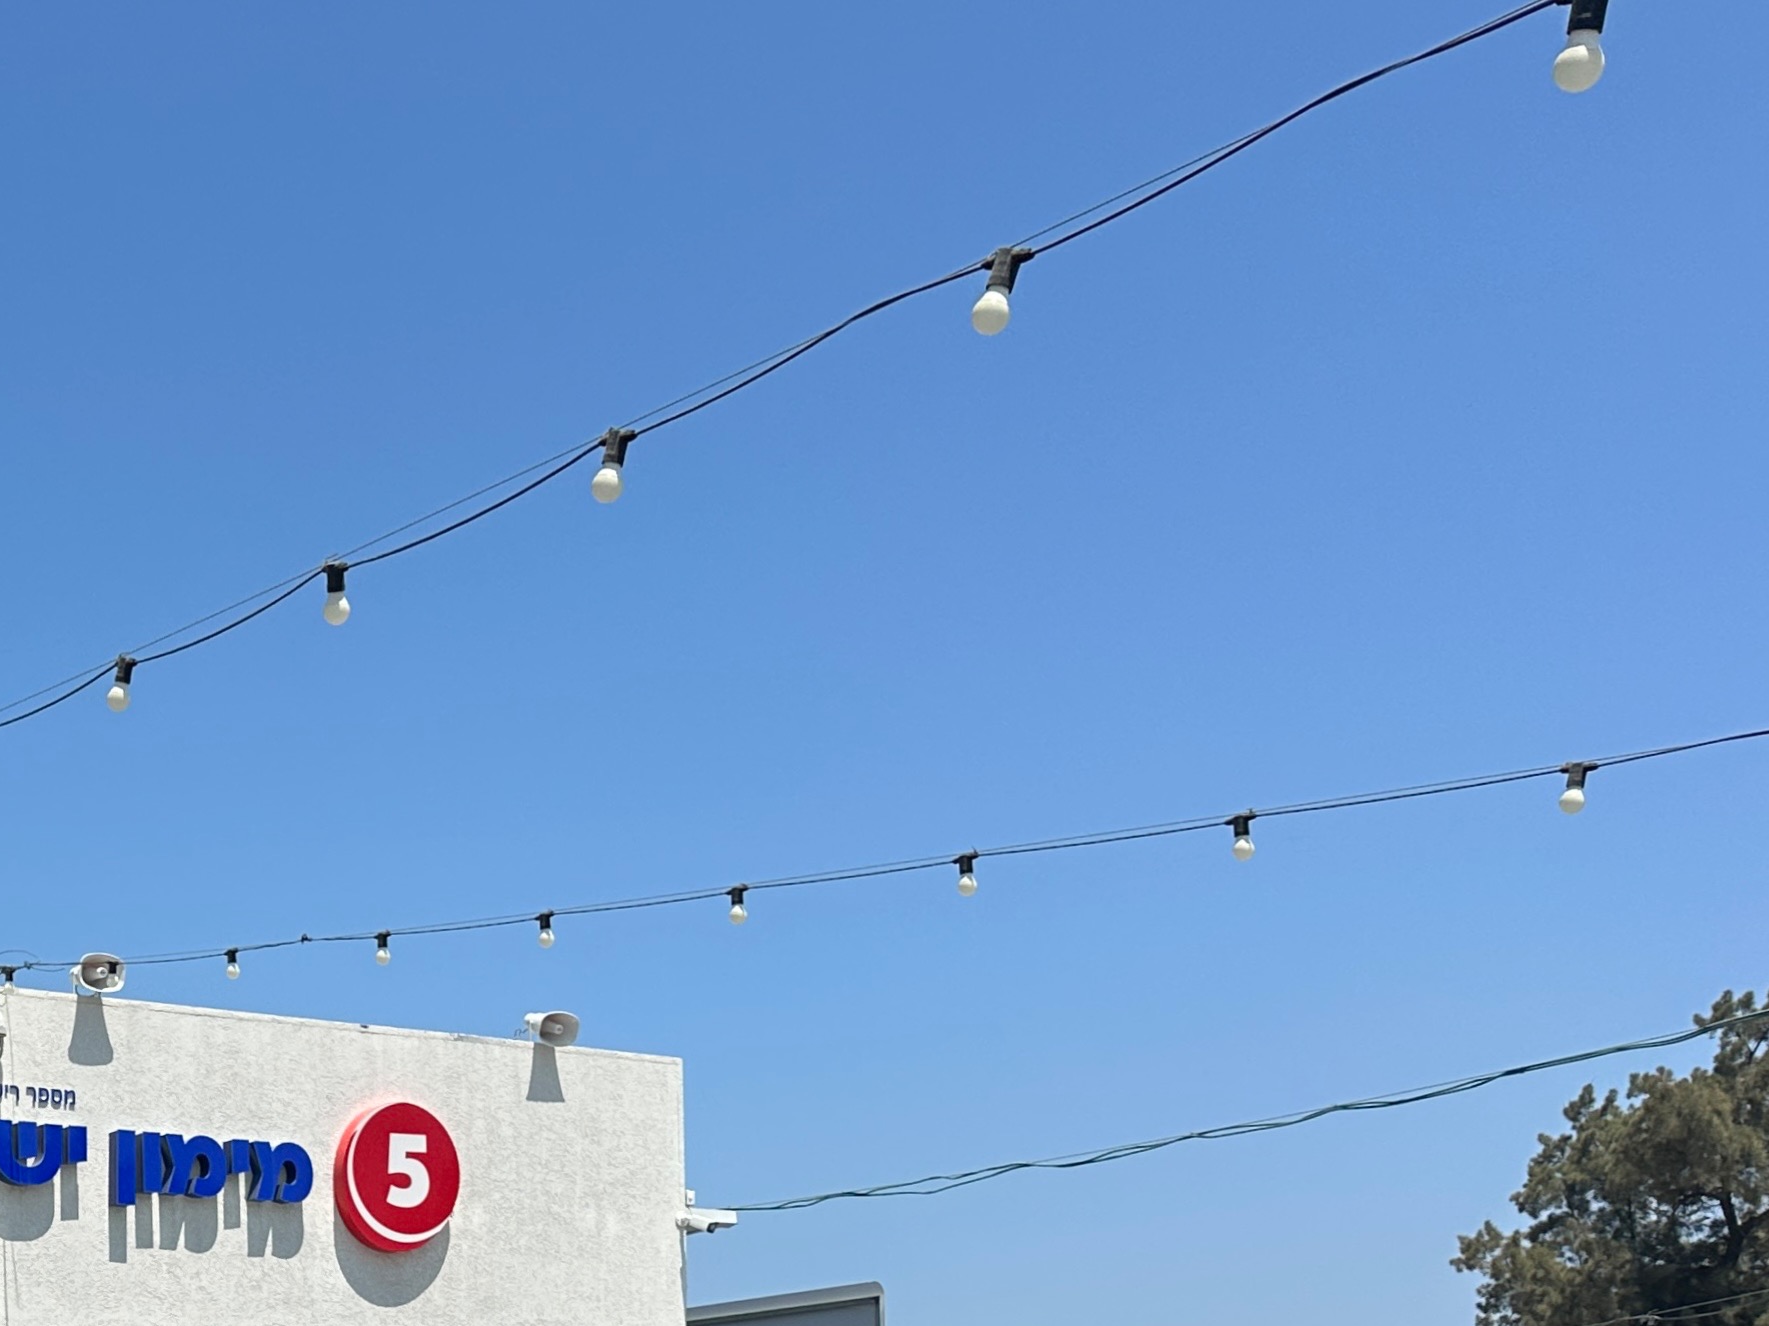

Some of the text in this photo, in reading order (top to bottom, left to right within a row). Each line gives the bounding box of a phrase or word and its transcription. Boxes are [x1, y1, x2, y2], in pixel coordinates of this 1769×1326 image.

[26, 1086, 76, 1107] מספר
[109, 1129, 313, 1207] מימון
[385, 1132, 432, 1209] 5
